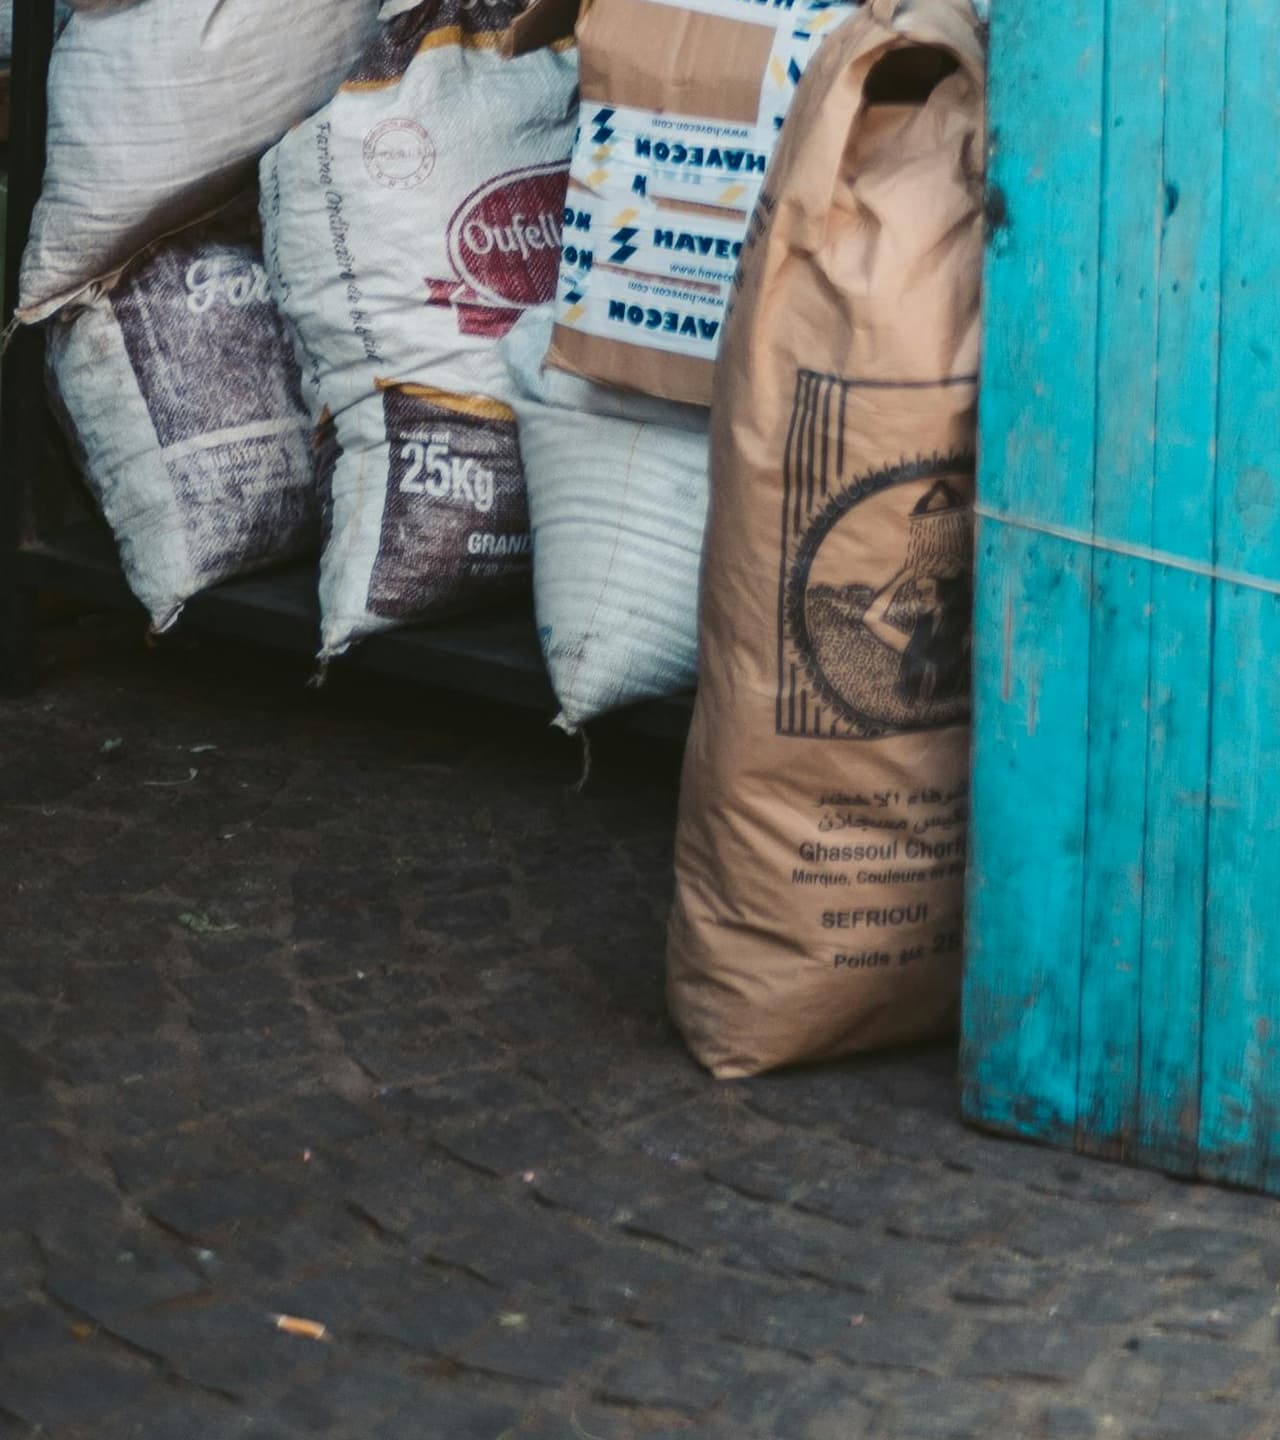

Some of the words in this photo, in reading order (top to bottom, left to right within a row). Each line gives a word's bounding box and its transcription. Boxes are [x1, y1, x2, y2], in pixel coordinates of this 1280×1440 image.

[635, 137, 767, 174] HAVECON
[462, 211, 562, 261] Oufell
[608, 300, 720, 341] AVECON
[399, 442, 495, 513] 25Kg
[799, 839, 898, 863] Ghassoul
[905, 837, 967, 860] Chorf
[821, 902, 928, 930] SEFRIOUI
[833, 950, 891, 970] Poids
